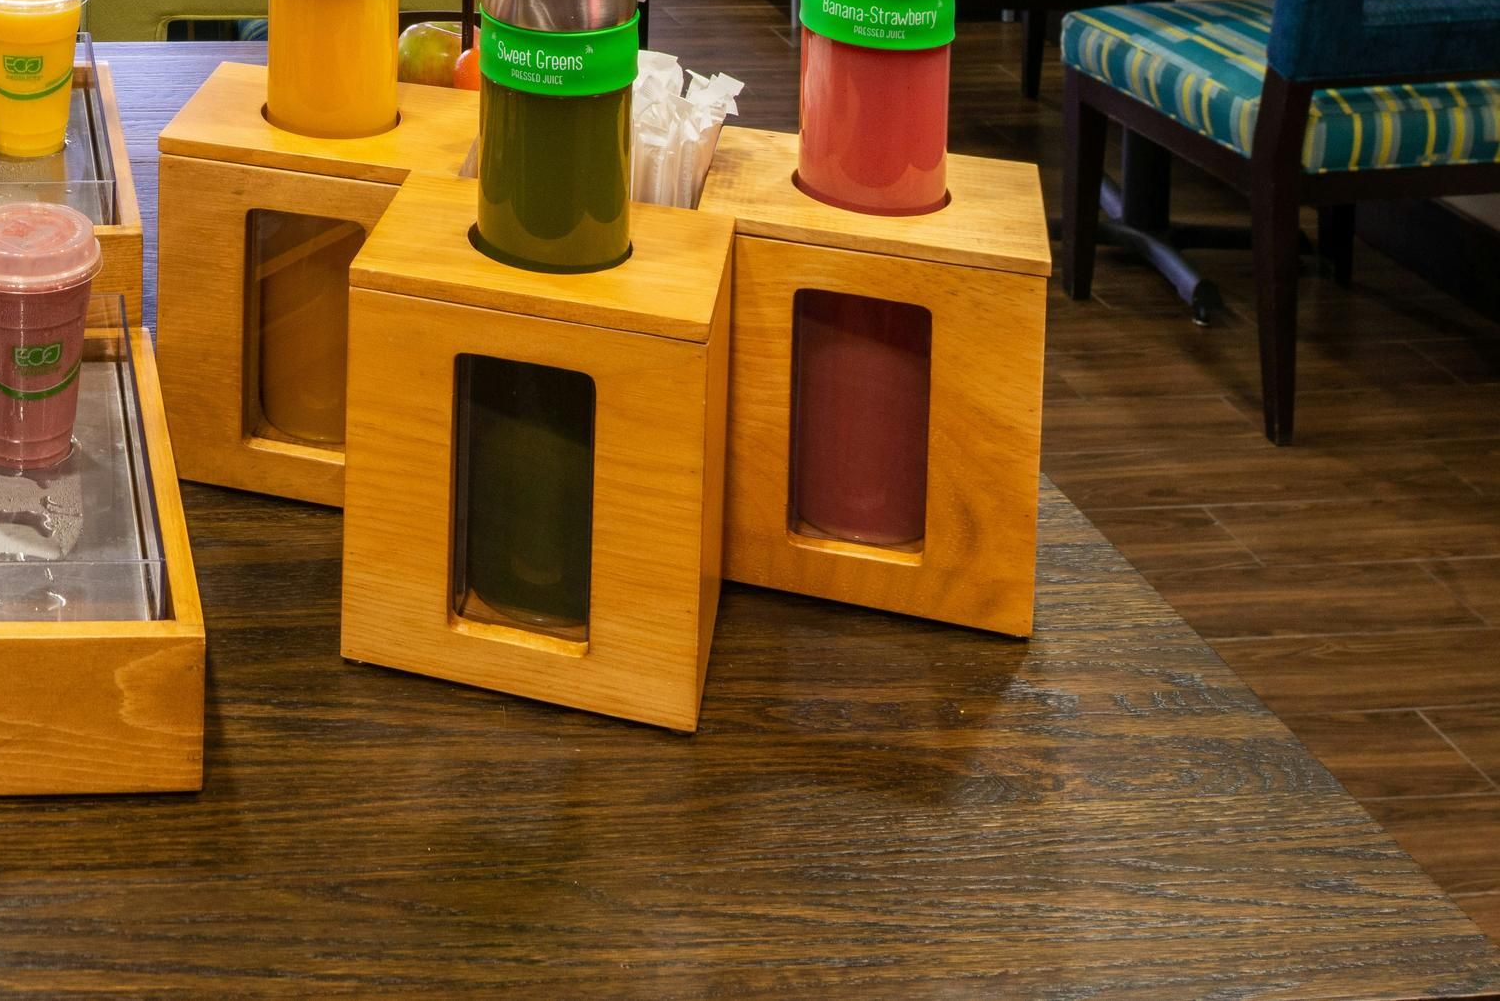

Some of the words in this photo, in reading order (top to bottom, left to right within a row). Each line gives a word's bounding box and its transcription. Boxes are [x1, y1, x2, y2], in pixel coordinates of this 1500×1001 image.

[853, 25, 885, 38] PRESSED
[886, 28, 906, 40] JUICE
[497, 40, 531, 67] Sweet
[536, 49, 584, 71] Greens
[511, 68, 541, 83] PRESSED
[542, 73, 564, 85] JUICE
